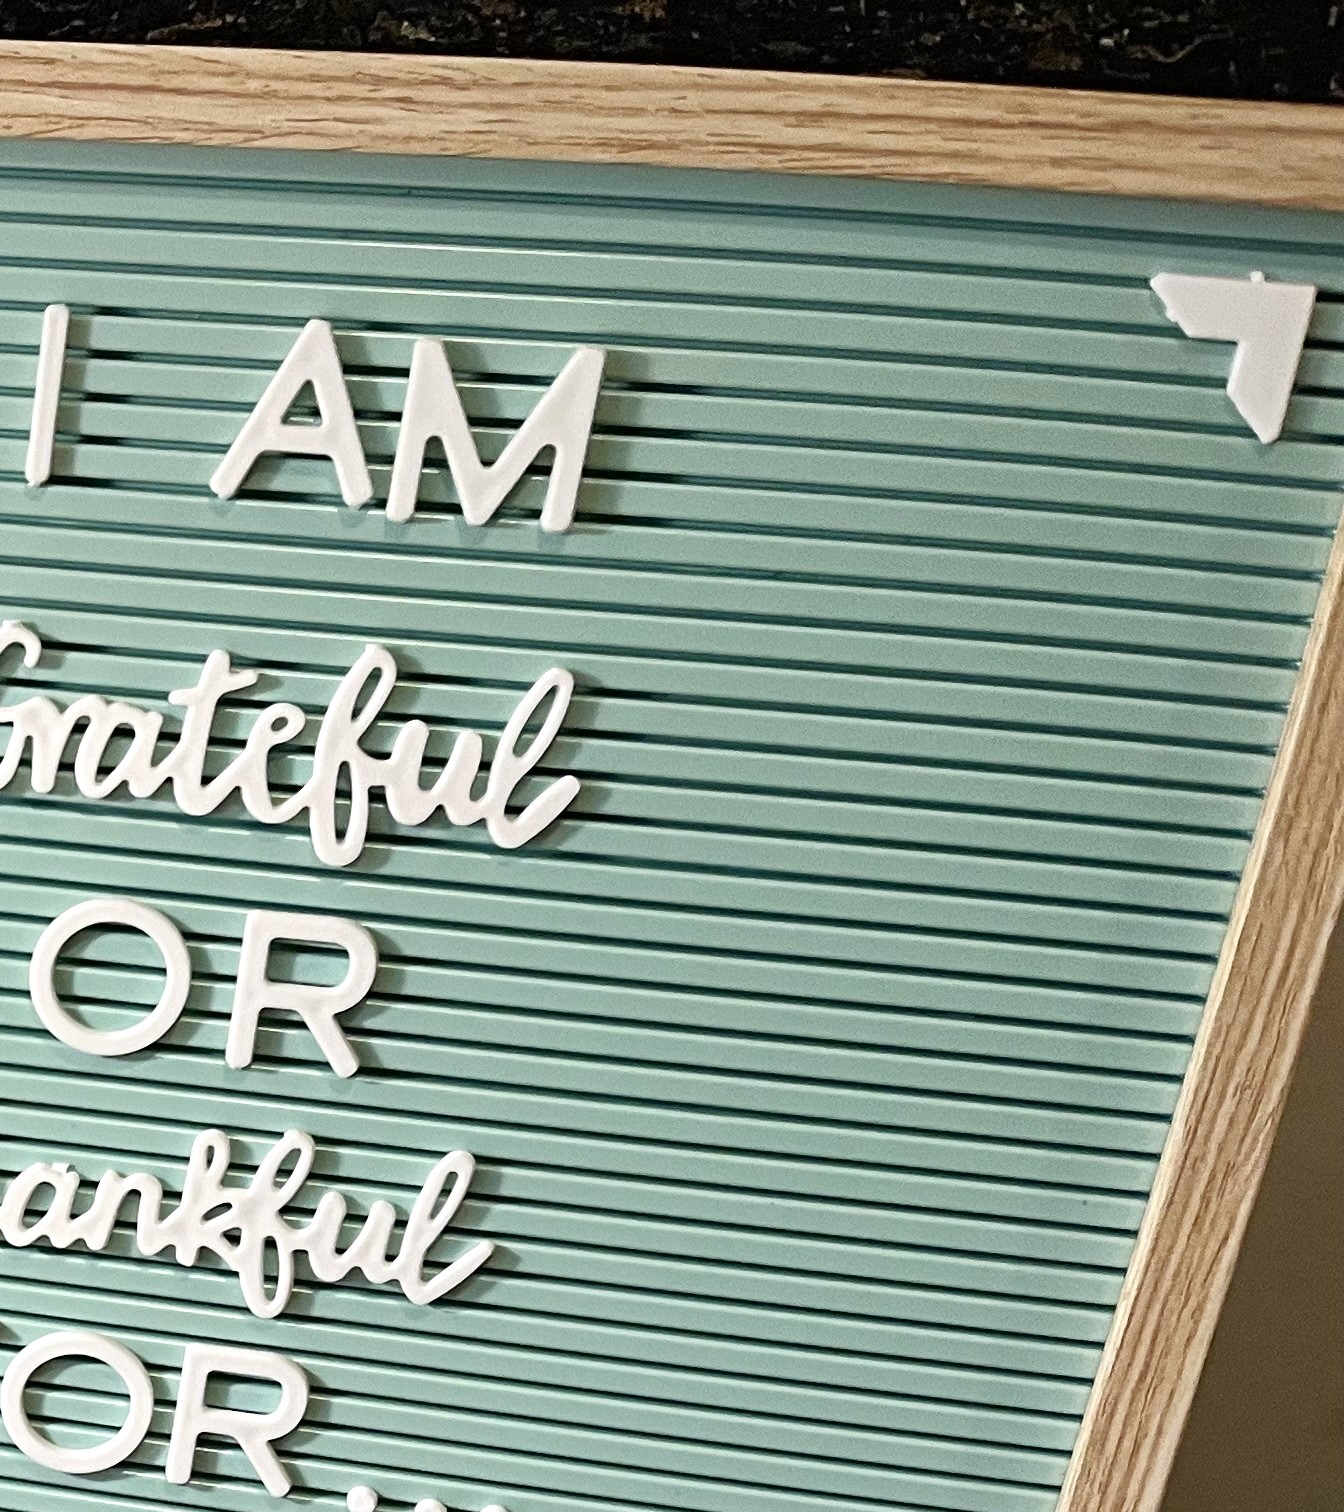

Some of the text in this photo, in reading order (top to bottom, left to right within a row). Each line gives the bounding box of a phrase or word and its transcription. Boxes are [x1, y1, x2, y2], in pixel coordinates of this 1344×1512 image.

[24, 303, 608, 535] I AM
[28, 896, 379, 1080] OR
